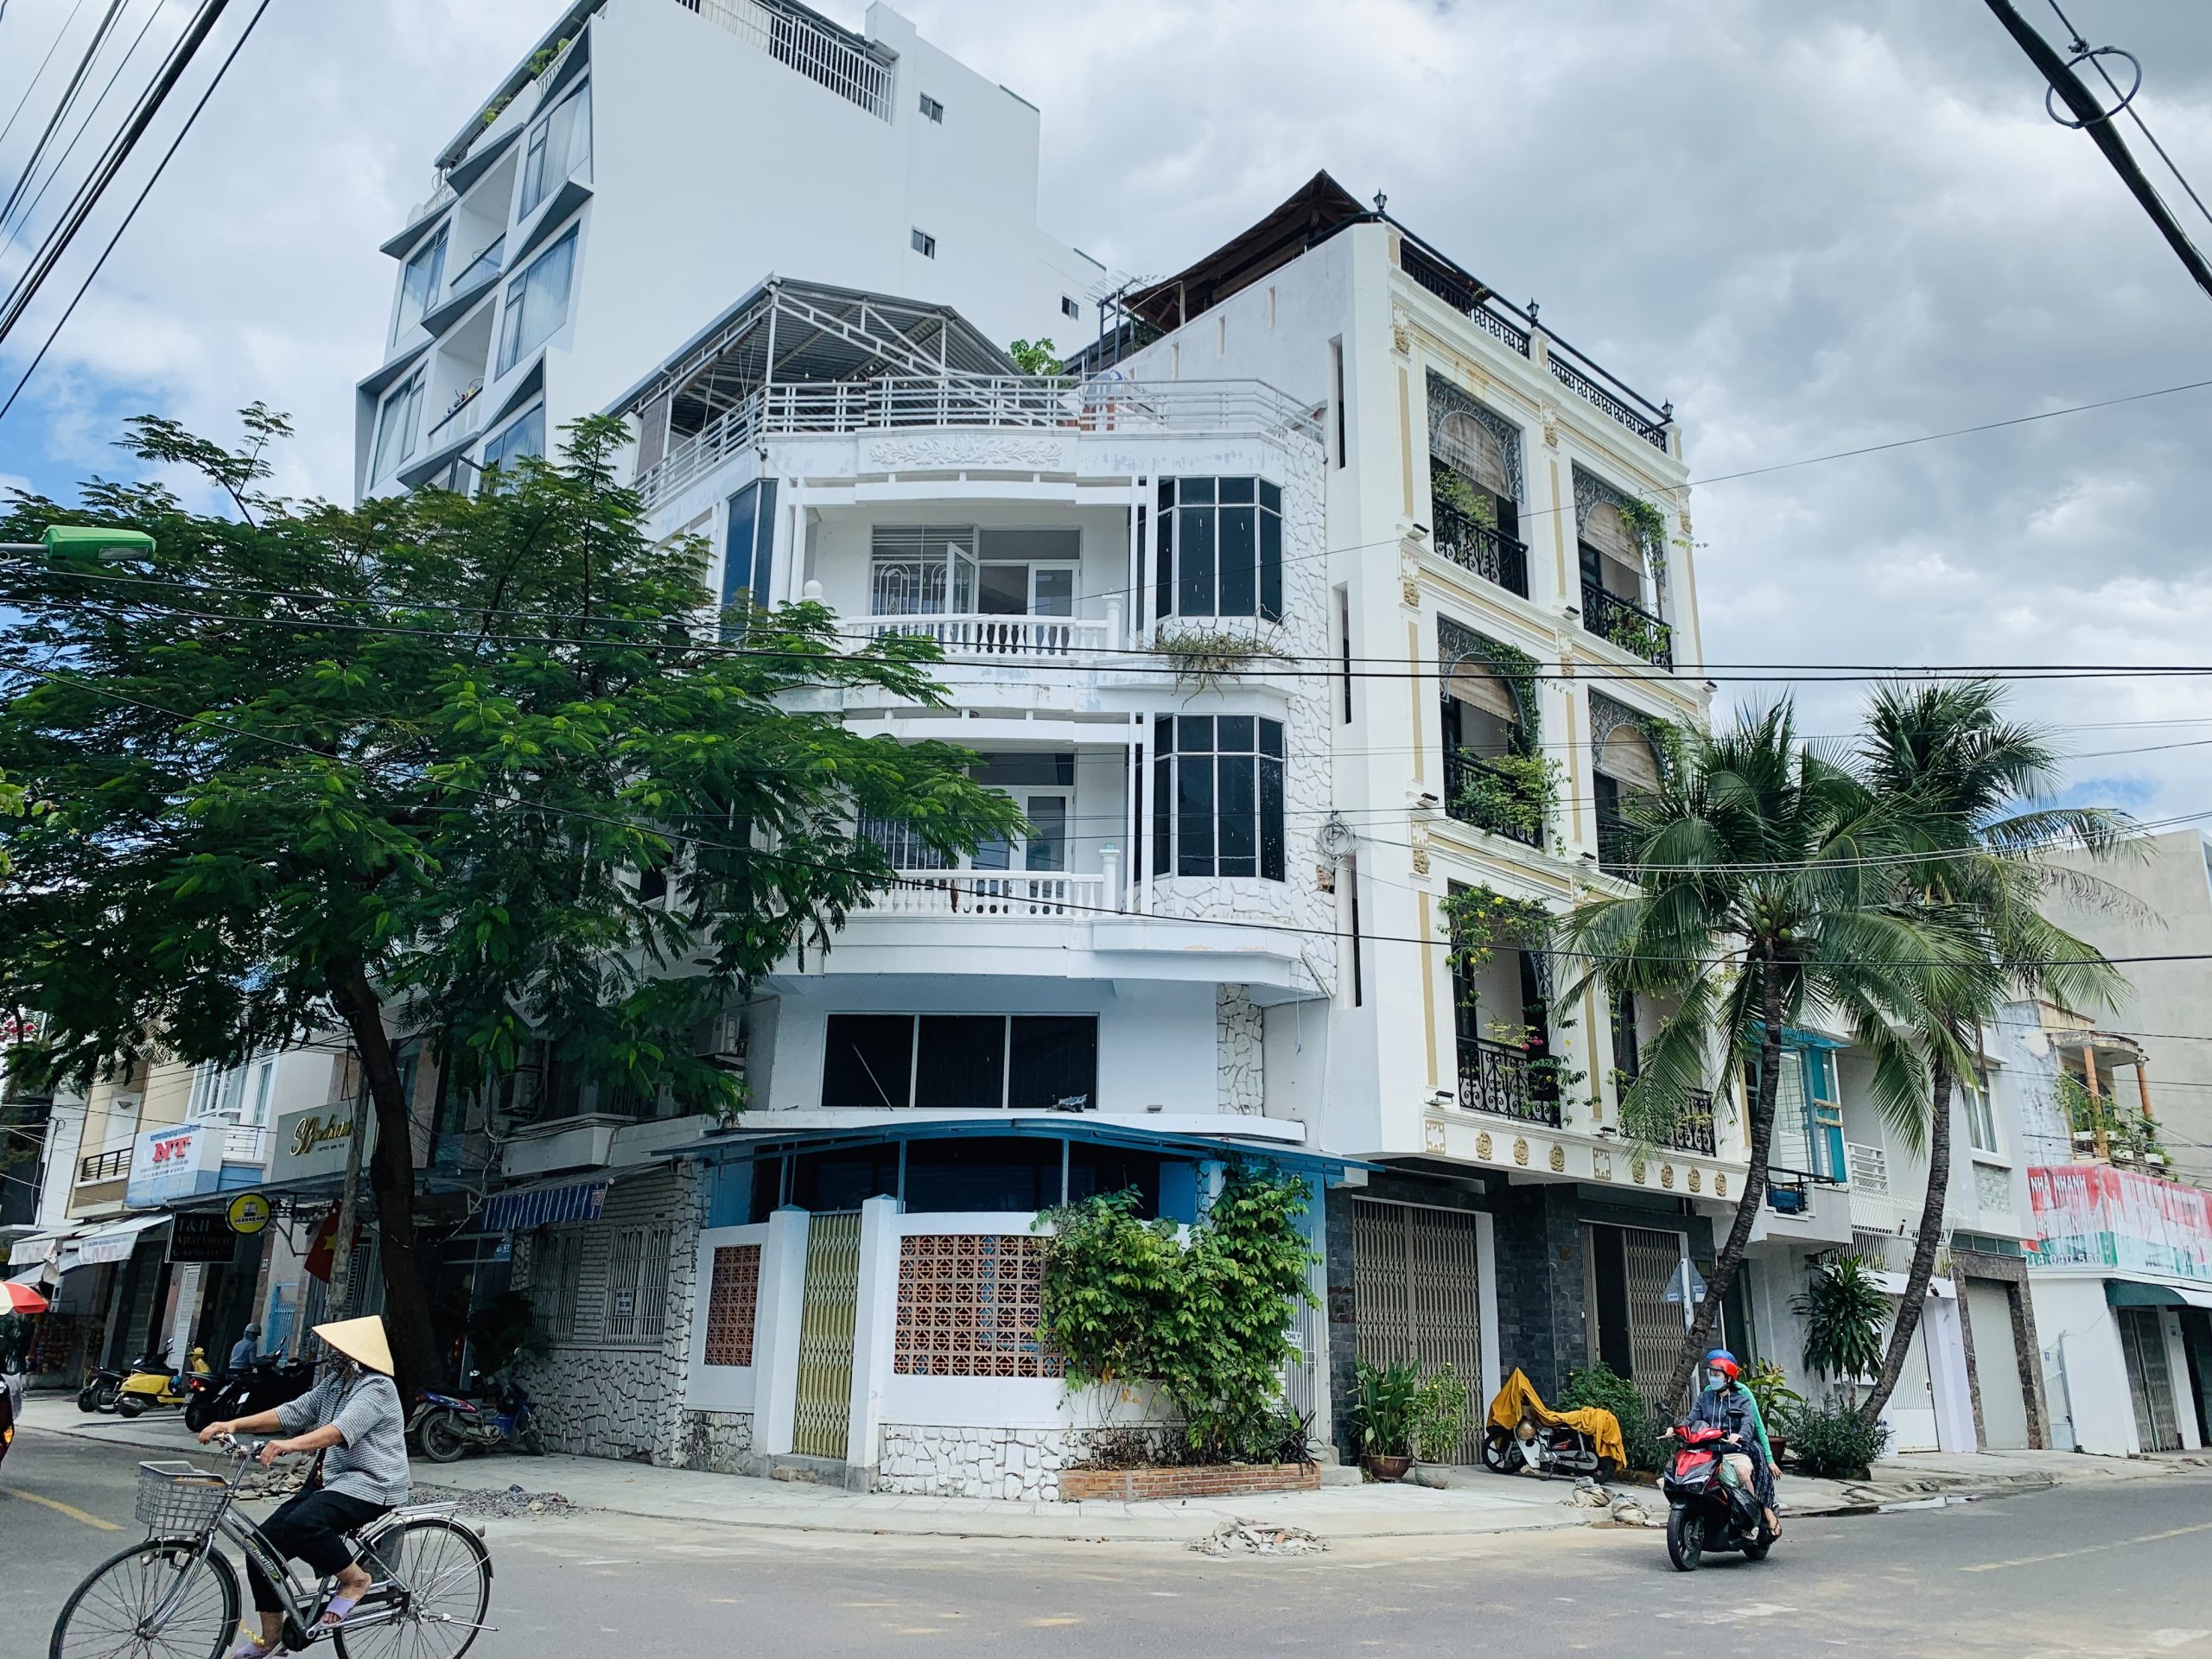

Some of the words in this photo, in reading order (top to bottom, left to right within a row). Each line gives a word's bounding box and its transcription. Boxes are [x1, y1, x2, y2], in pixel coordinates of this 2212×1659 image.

[152, 1136, 193, 1162] NT
[2052, 1174, 2086, 1193] NHANH
[2049, 1253, 2074, 1266] 040
[252, 1548, 275, 1572] martin
